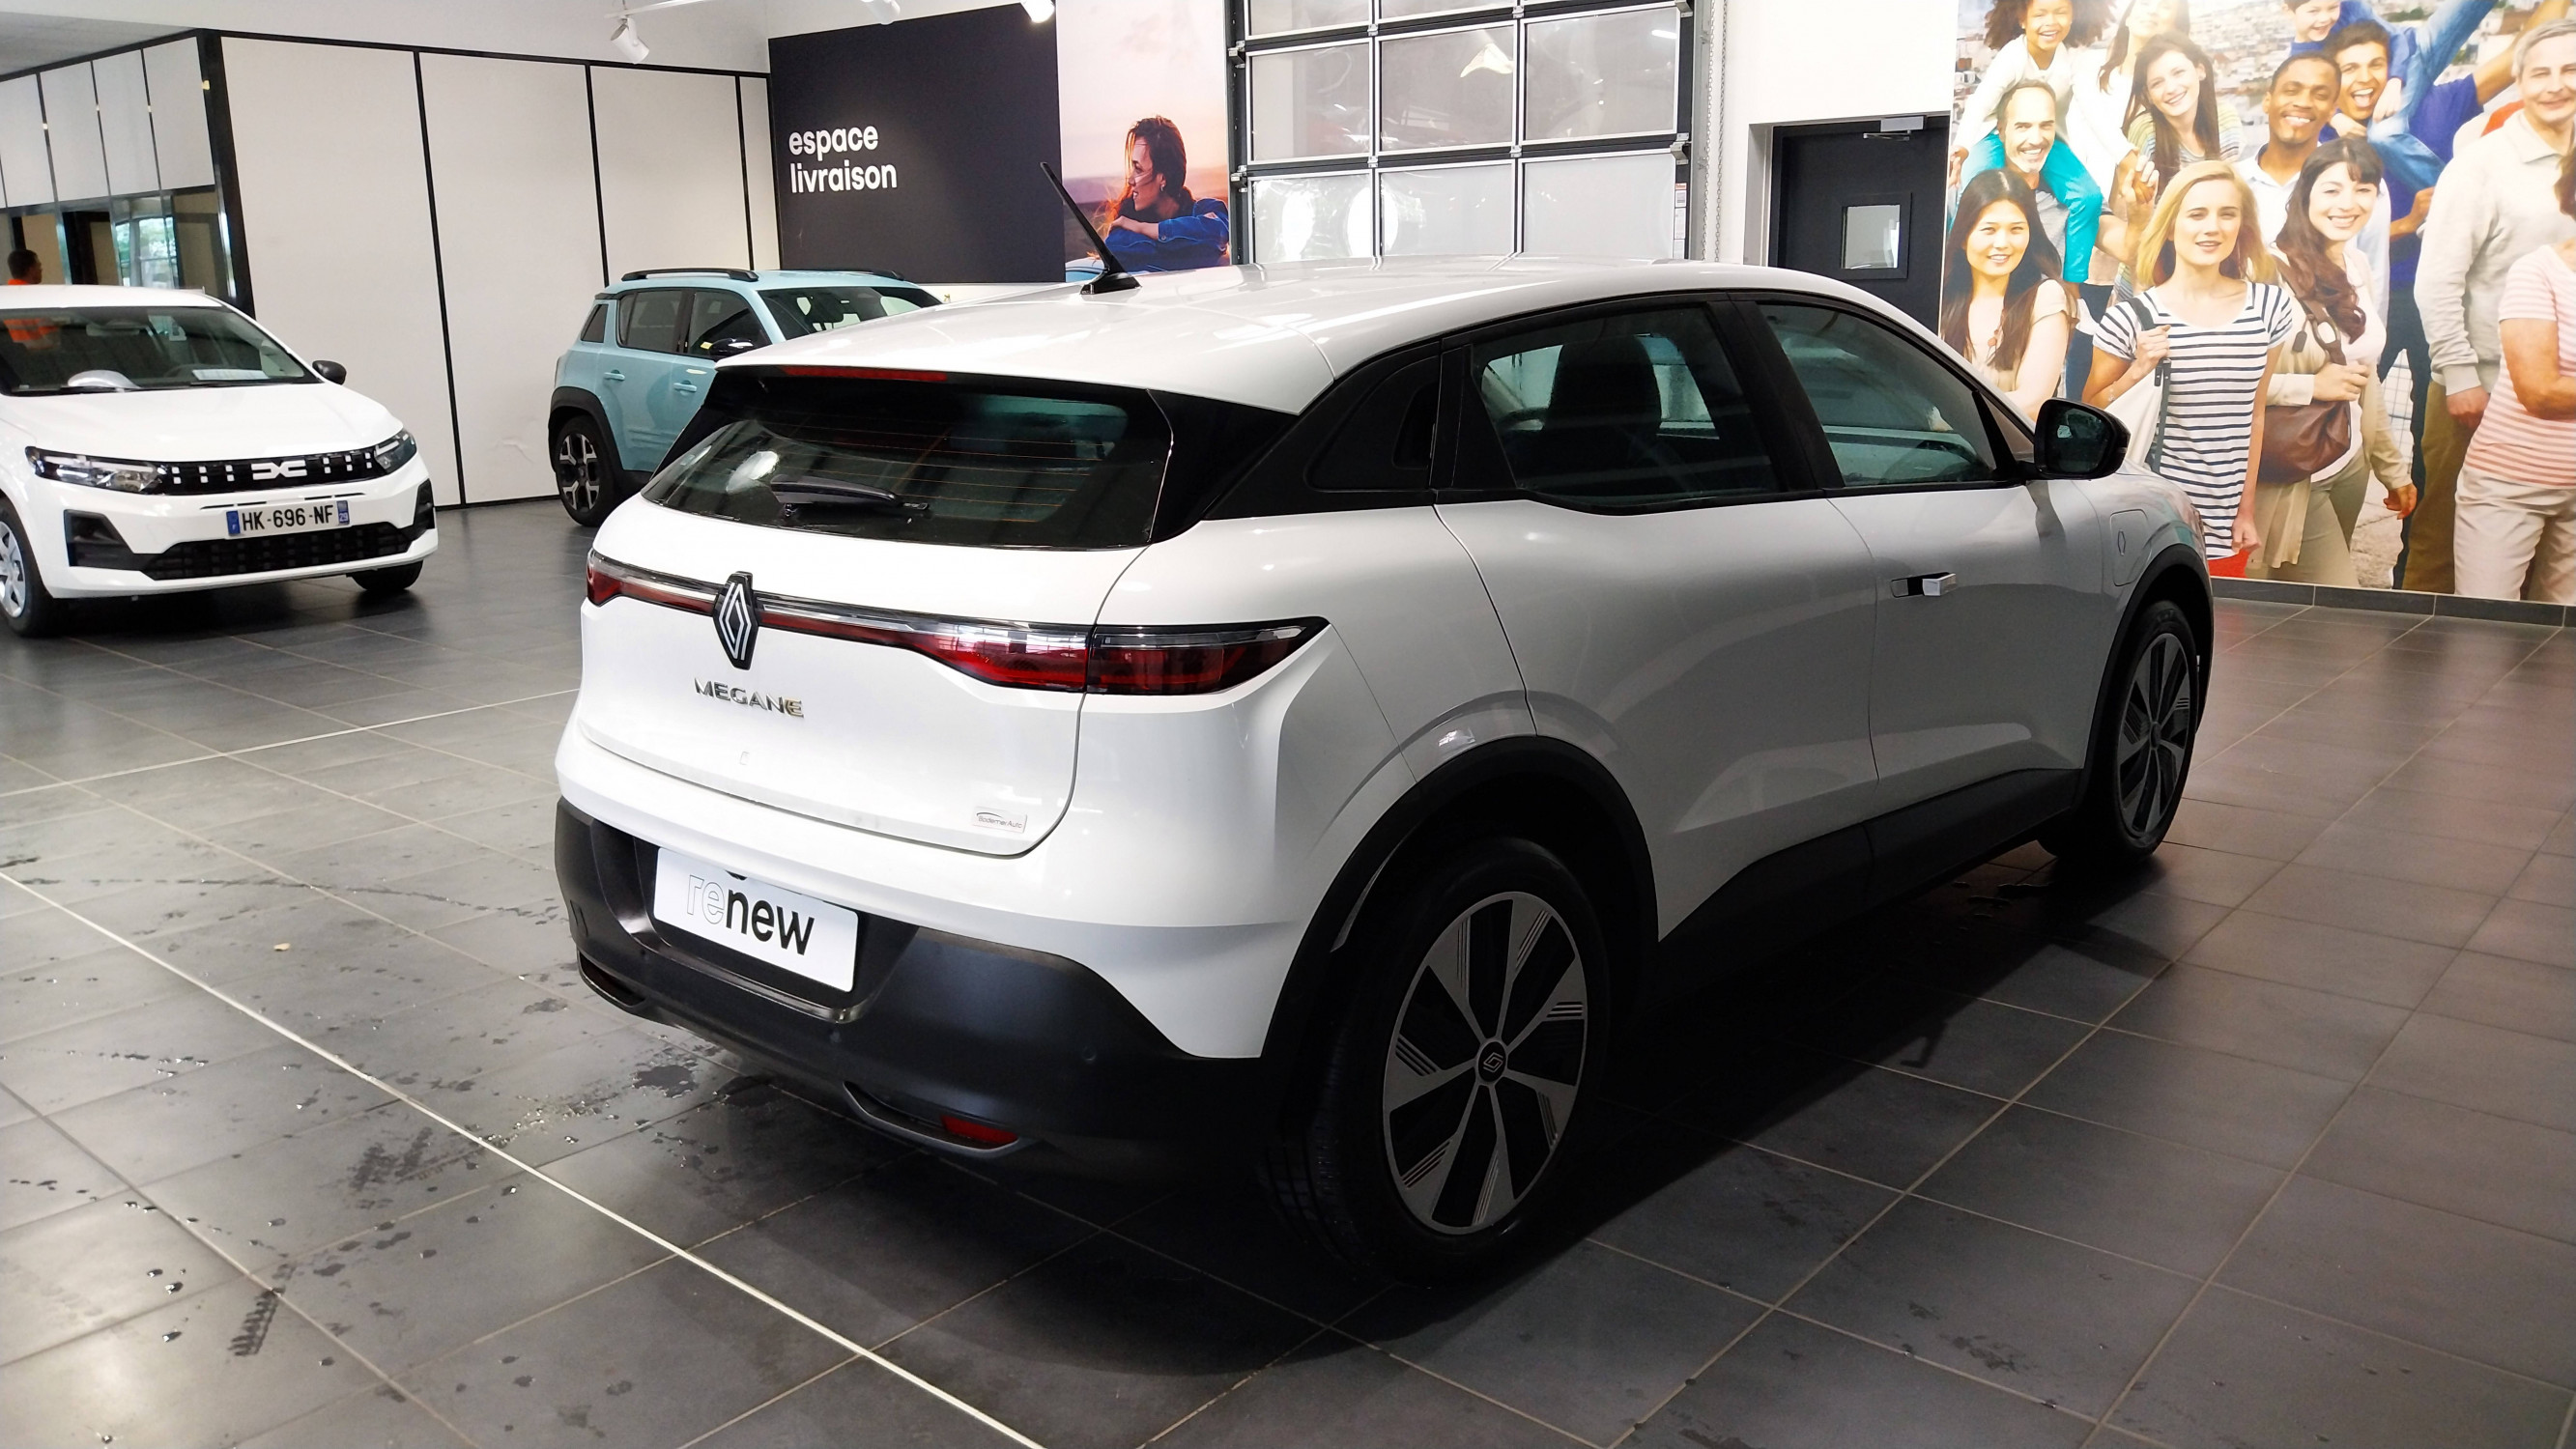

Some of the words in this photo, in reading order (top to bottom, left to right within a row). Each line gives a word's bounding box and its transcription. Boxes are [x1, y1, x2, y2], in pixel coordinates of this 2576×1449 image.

[788, 126, 878, 161] espace
[789, 159, 898, 193] livraison
[338, 512, 349, 523] 29
[694, 677, 804, 718] MEGANE
[686, 874, 816, 955] renew
